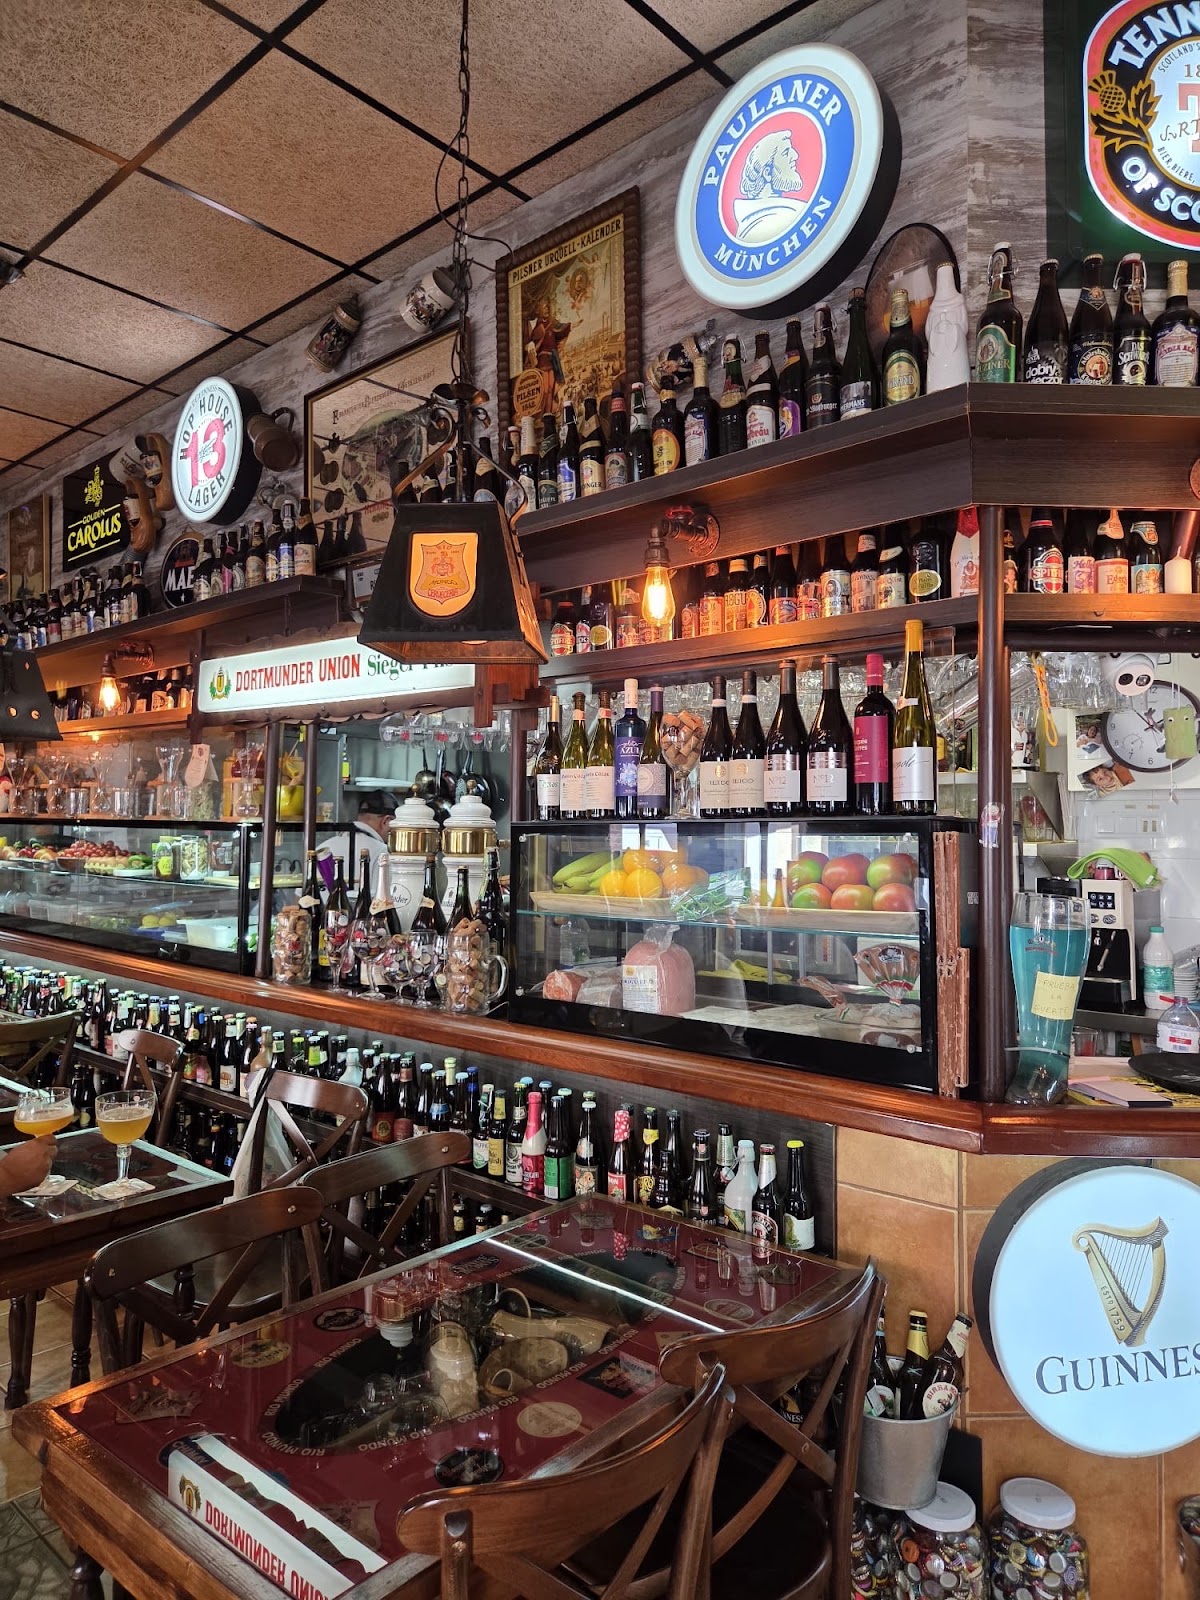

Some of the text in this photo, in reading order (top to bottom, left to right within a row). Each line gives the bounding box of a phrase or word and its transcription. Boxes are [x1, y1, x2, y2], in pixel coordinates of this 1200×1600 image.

[704, 79, 842, 186] PAULANER
[1122, 156, 1158, 194] OF
[714, 195, 832, 272] MÜNCHEN
[512, 259, 542, 283] PILSNER
[1131, 342, 1144, 352] DAS
[516, 386, 540, 400] PILSEN
[180, 394, 232, 460] HOP HOUSE
[186, 418, 226, 488] 13
[188, 472, 225, 506] LAGER
[82, 508, 106, 524] GOUDEN
[68, 512, 122, 552] CAROLUS
[164, 566, 195, 592] MAE
[236, 662, 314, 692] DORTMUNDER
[319, 654, 361, 682] UNION
[1128, 752, 1134, 760] 7
[1108, 1306, 1126, 1331] 1759
[536, 1361, 588, 1390] RIO MUNDO
[926, 1384, 948, 1400] BIRRA
[457, 1395, 520, 1424] RIO MUNDO
[262, 1430, 326, 1457] RIO MUNDO
[358, 1428, 433, 1452] RIO MUNDO
